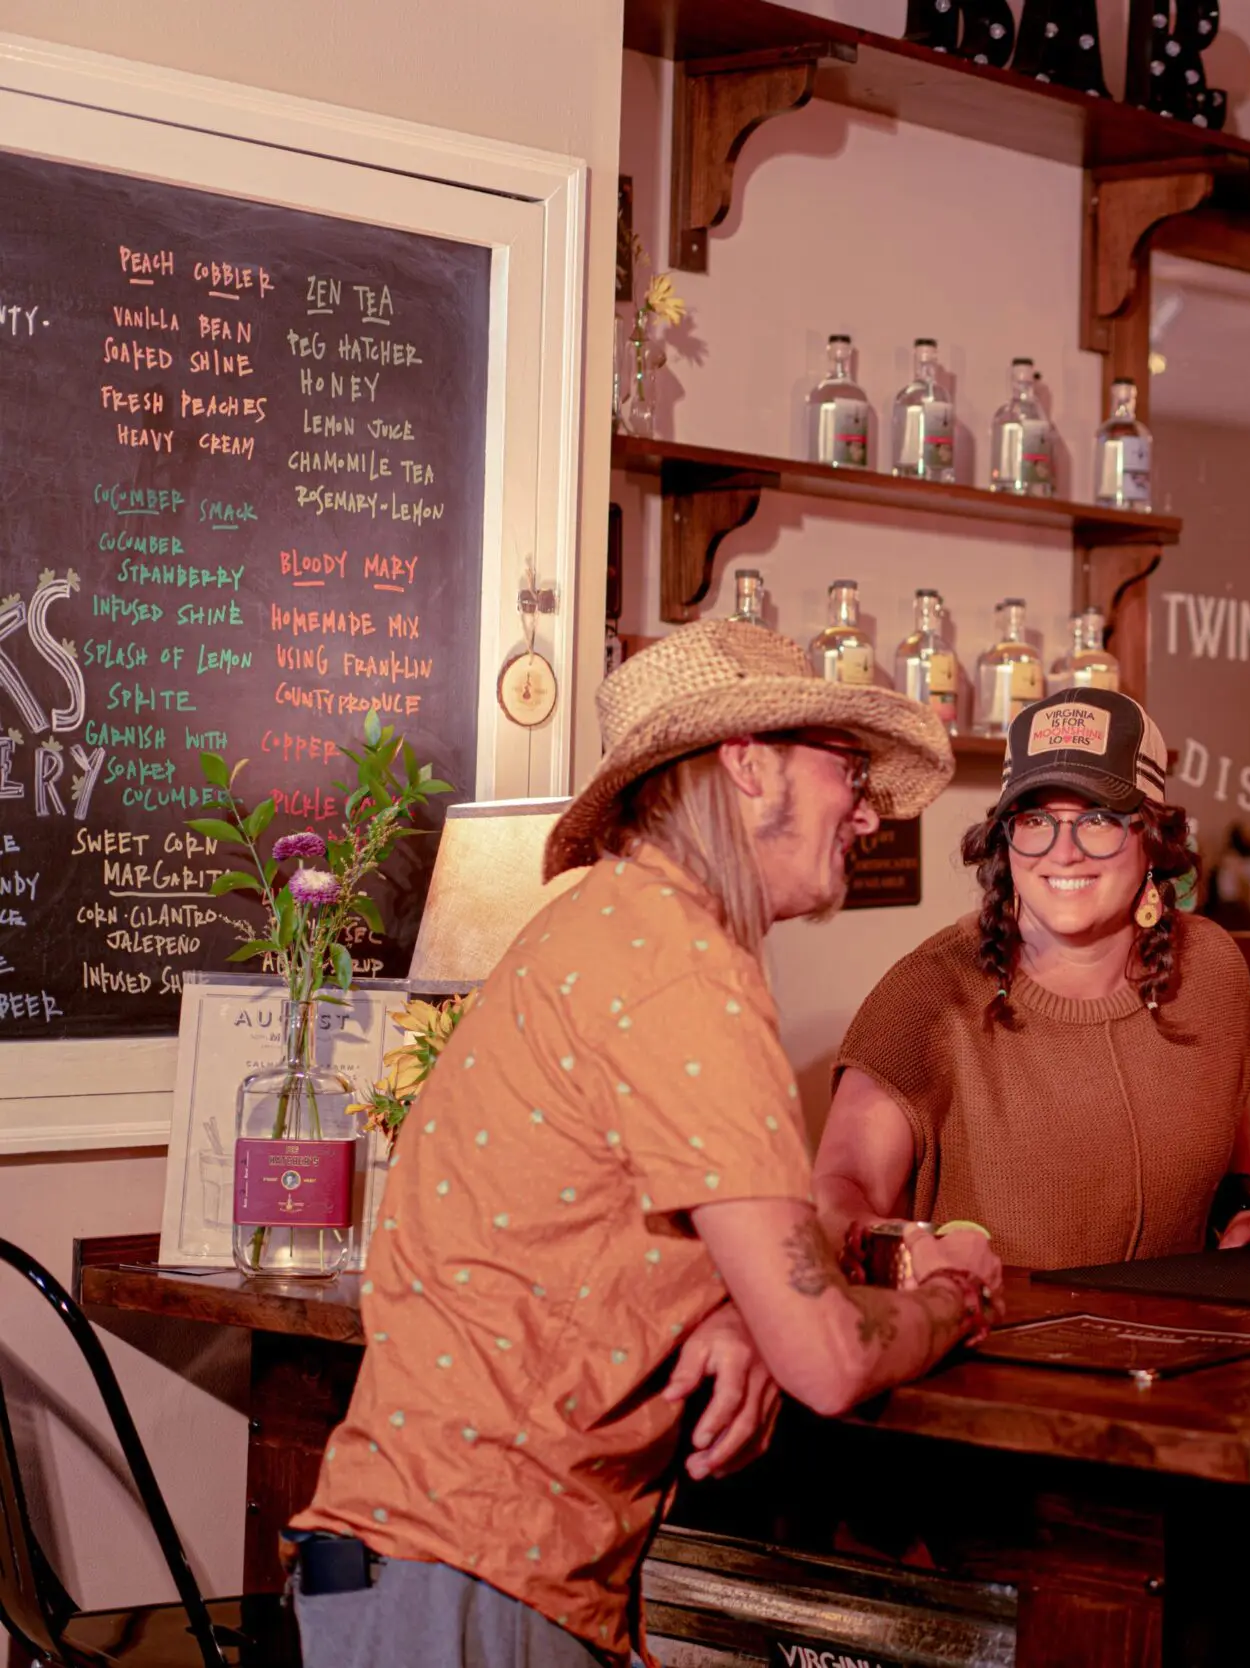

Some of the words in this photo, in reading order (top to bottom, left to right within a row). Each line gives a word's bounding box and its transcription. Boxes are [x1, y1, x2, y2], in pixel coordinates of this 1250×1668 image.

[119, 245, 175, 276] PEACH
[193, 261, 275, 298] COBBLER
[306, 275, 342, 308] ZEN
[352, 284, 394, 318] TEA
[113, 305, 179, 332] VANILLA
[198, 313, 252, 344] BEAN
[103, 336, 173, 371] SOAKED
[189, 349, 254, 377] SHINE
[286, 328, 327, 360] PEG
[338, 332, 423, 368] HATCHER
[300, 368, 380, 402] HONEY
[100, 385, 164, 415] FRESH
[181, 389, 268, 423] PEACHES
[117, 423, 174, 453] HEAVY
[198, 432, 255, 461] CREAM
[303, 408, 355, 439] LEMON
[367, 418, 416, 441] JUICE
[287, 449, 392, 482] CHAMOMILE
[400, 460, 435, 486] TEA
[93, 482, 185, 513] CUCUMBER
[198, 498, 258, 523] SMACK
[98, 530, 185, 557] CUCUMBER
[116, 557, 245, 592] STRAWBERRY
[279, 548, 348, 579] BLOODY
[363, 553, 419, 585] MARY
[91, 593, 164, 627] INFUSED
[176, 599, 244, 627] SHINE
[270, 602, 377, 638] HOMEMADE
[387, 612, 420, 640] MIX
[82, 637, 148, 670] SPLASH
[159, 646, 185, 670] OF
[196, 643, 253, 676] LEMON
[275, 643, 329, 677] USING
[343, 650, 434, 684] FRANKLIN
[106, 680, 198, 715] SPRITE
[1045, 708, 1095, 721] VIRGINIA
[84, 719, 166, 750] GARNISH
[185, 726, 229, 751] WITH
[1033, 726, 1104, 741] MOONSHINE
[1051, 718, 1061, 728] IS
[1062, 717, 1086, 728] FOR
[260, 729, 343, 766] COPPER
[269, 786, 339, 821] PICKLE
[71, 826, 151, 857] SWEET
[163, 831, 218, 860] CORN
[103, 859, 232, 893] MARGARIT
[75, 902, 118, 930] CORN
[82, 960, 152, 995] INFUSED
[233, 1008, 351, 1031] AUST
[776, 1641, 883, 1668] VIRG
